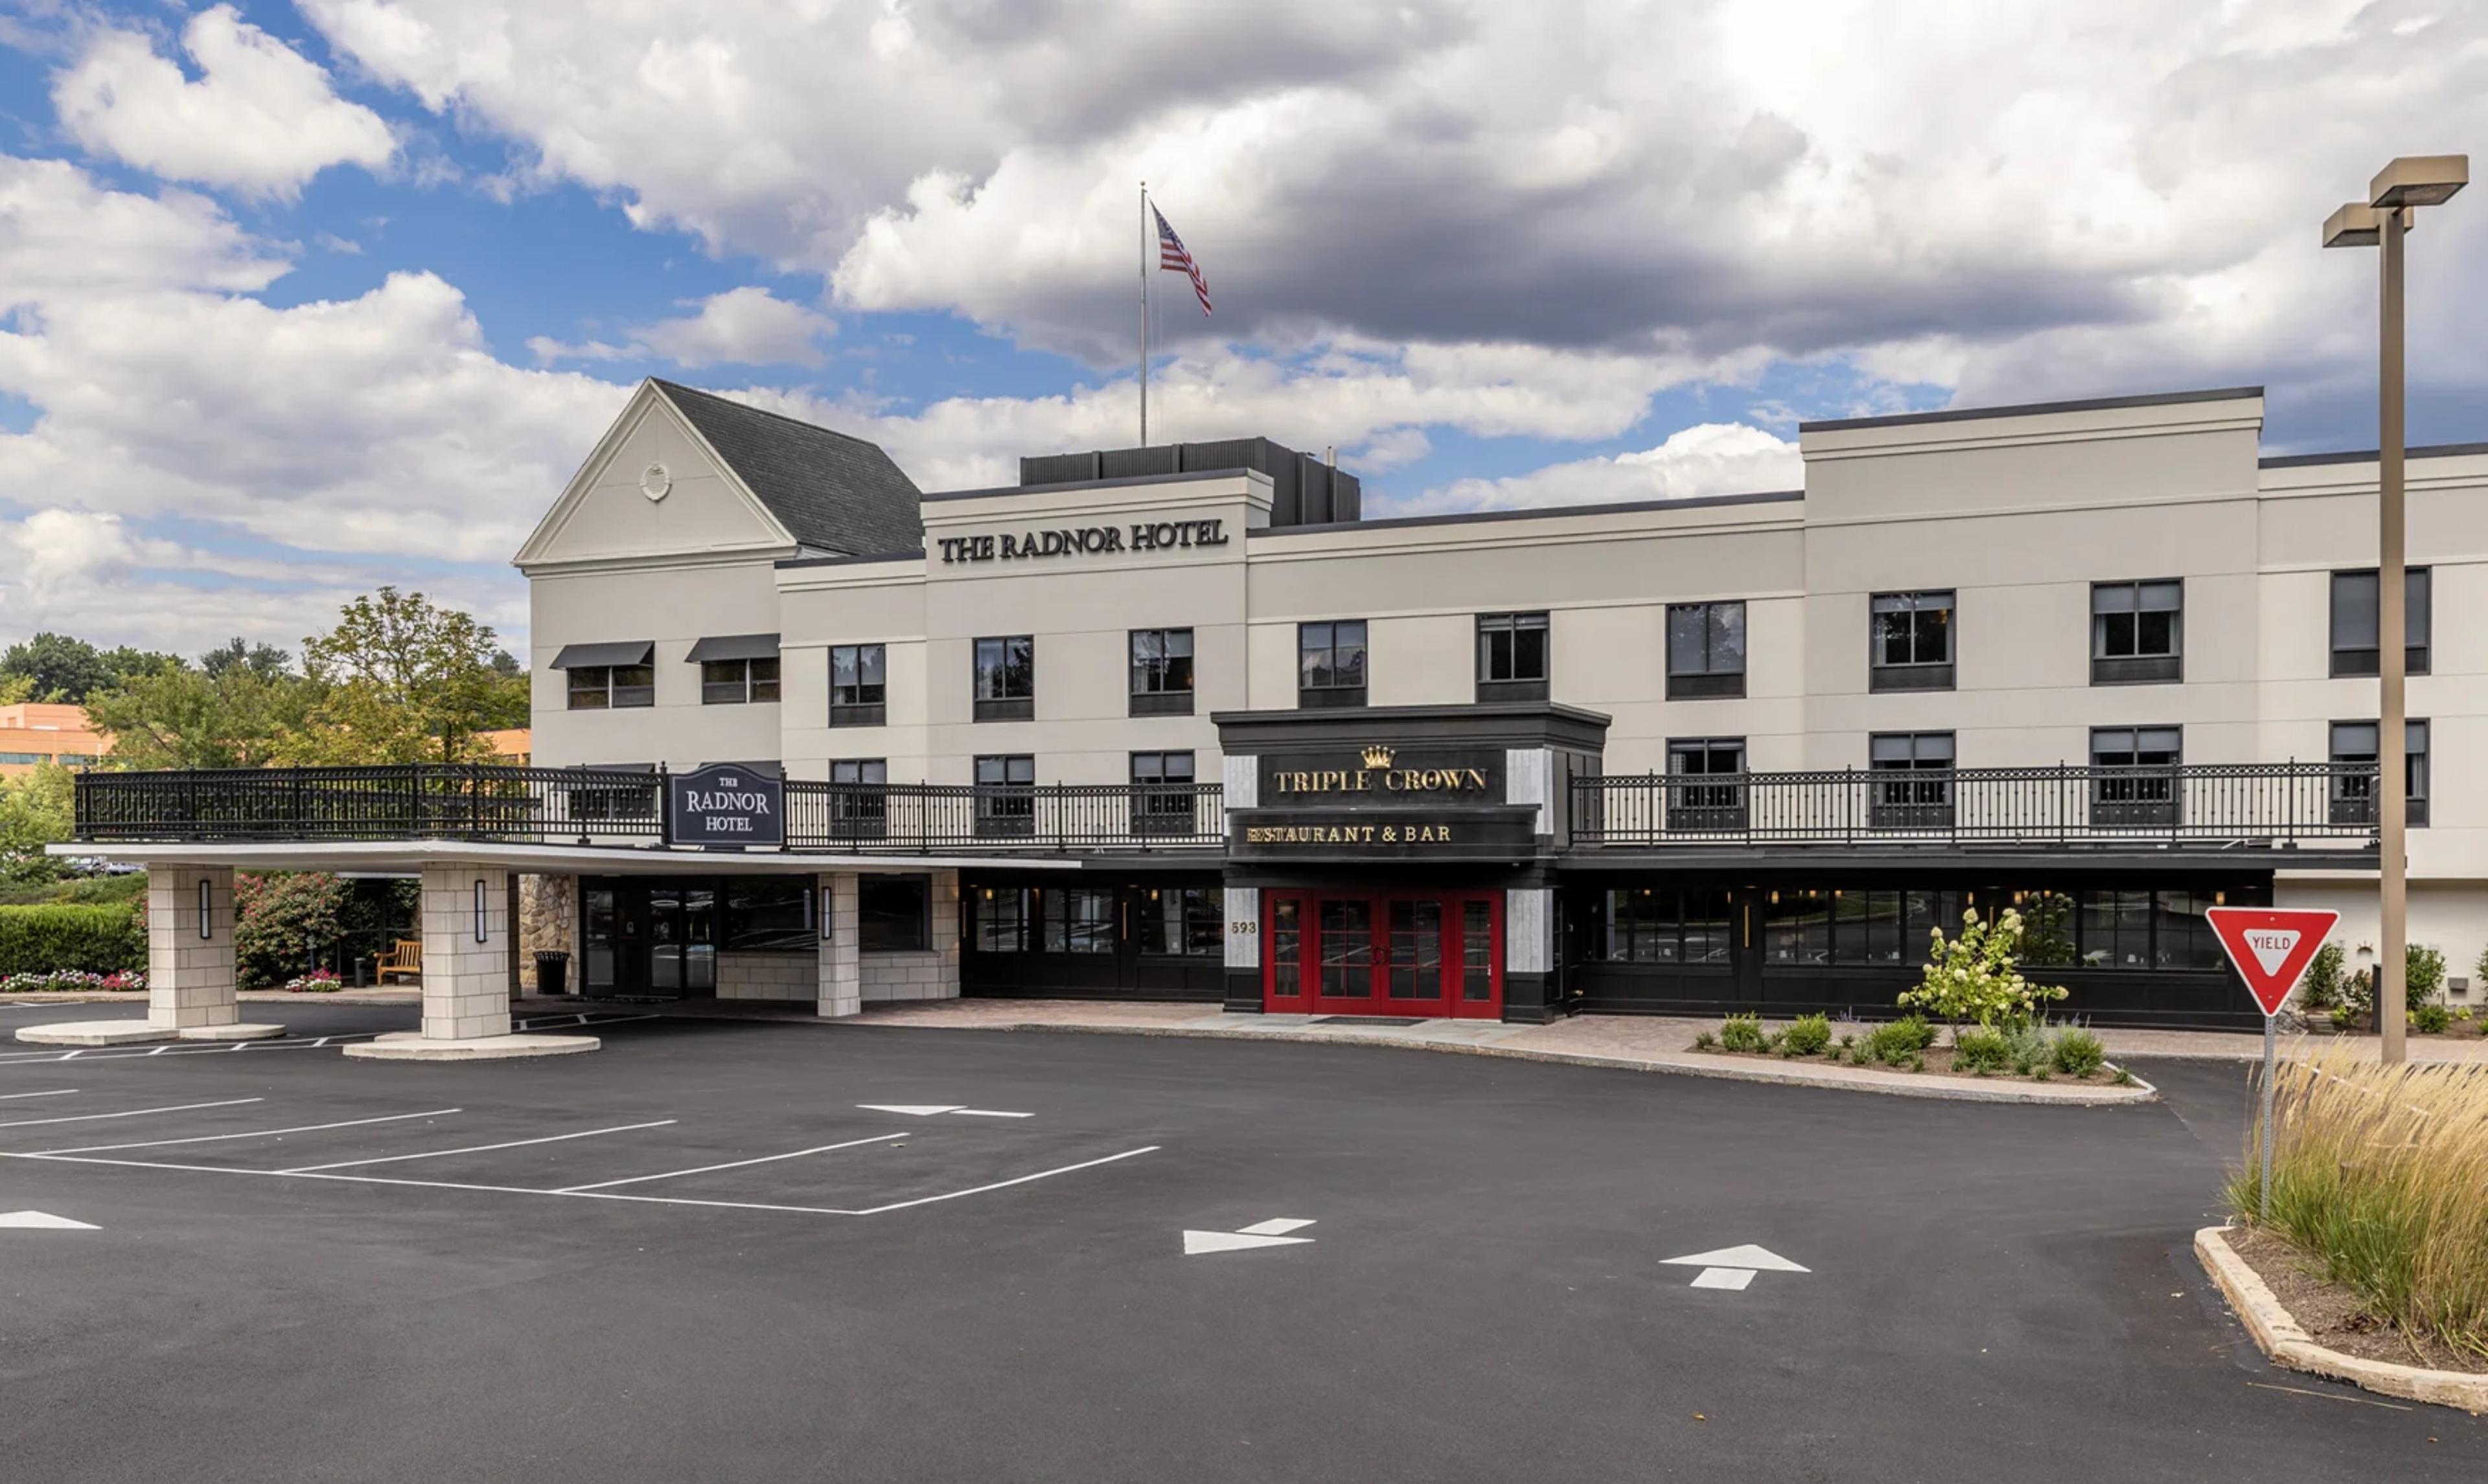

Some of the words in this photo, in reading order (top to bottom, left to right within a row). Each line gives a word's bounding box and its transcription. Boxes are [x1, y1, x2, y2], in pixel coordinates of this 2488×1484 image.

[938, 535, 995, 562] THE
[998, 526, 1125, 558] RADNOR
[1130, 519, 1229, 550] HOTEL
[719, 777, 738, 788] THE
[1274, 771, 1372, 793] TRIPLE
[1385, 768, 1488, 792] CROWN
[686, 790, 770, 814] RADNOR
[706, 816, 753, 832] HOTEL
[1247, 827, 1375, 842] RESTAURANT
[1381, 827, 1397, 842] &
[1405, 826, 1451, 842] BAR
[1231, 921, 1256, 934] 593
[2252, 937, 2291, 950] YIELD
